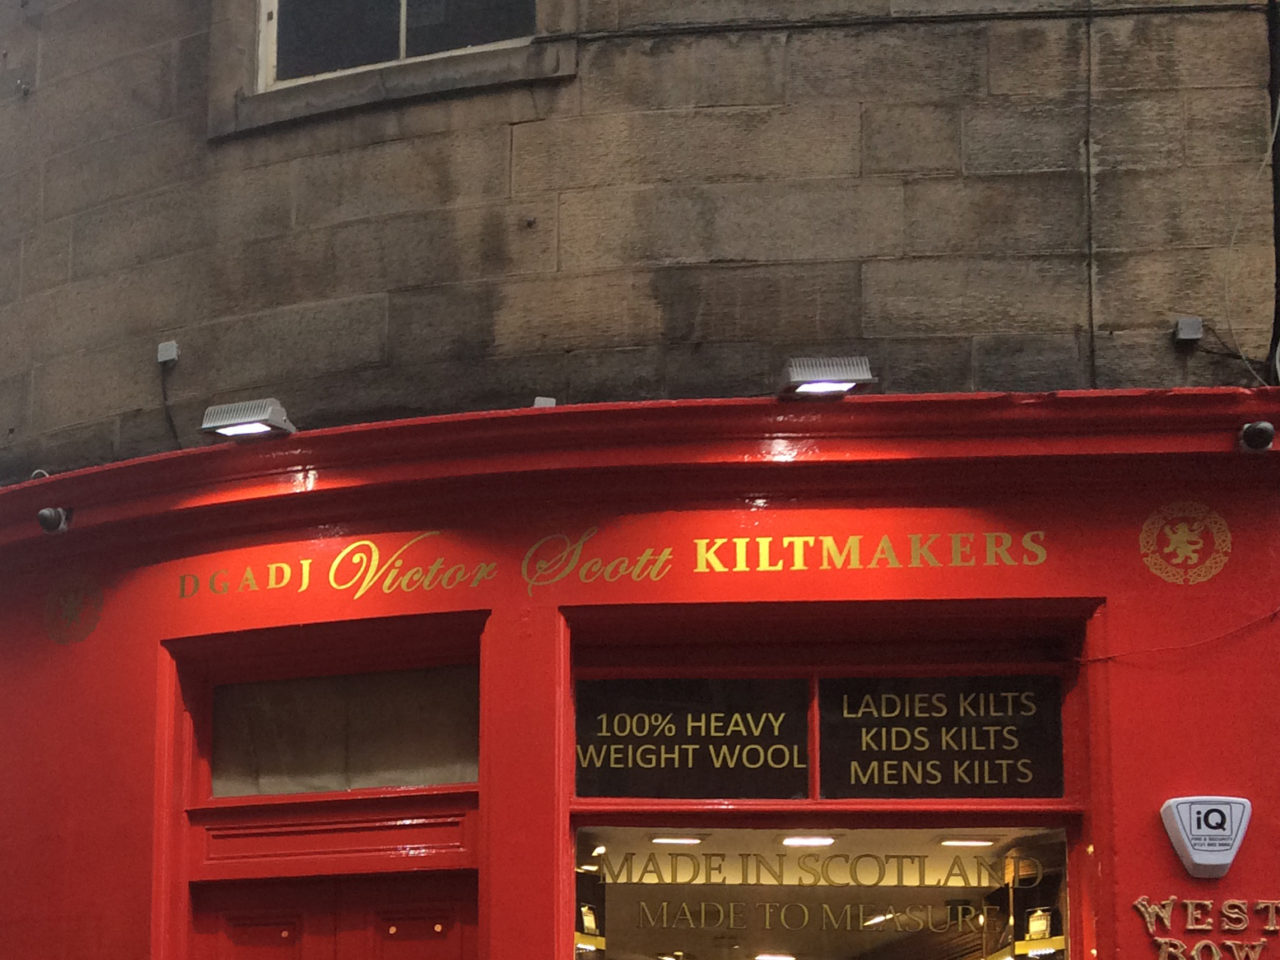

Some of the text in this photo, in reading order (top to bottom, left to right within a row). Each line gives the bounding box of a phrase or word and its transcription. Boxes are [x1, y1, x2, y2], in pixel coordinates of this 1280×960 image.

[328, 530, 498, 600] Victor
[521, 526, 673, 598] Scott
[694, 530, 1048, 574] KILTMAKERS
[843, 691, 1038, 718] LADIES KILTS
[596, 711, 786, 737] 100% HEAVY
[861, 725, 1019, 751] KIDS KILTS
[576, 743, 808, 769] WEIGHT WOOL
[850, 759, 1034, 786] MENS KILTS
[1196, 808, 1227, 832] iQ
[598, 852, 1043, 889] MADE IN SCOTLAND
[638, 901, 1001, 934] MADE TO MEASURE
[1133, 895, 1280, 935] WEST
